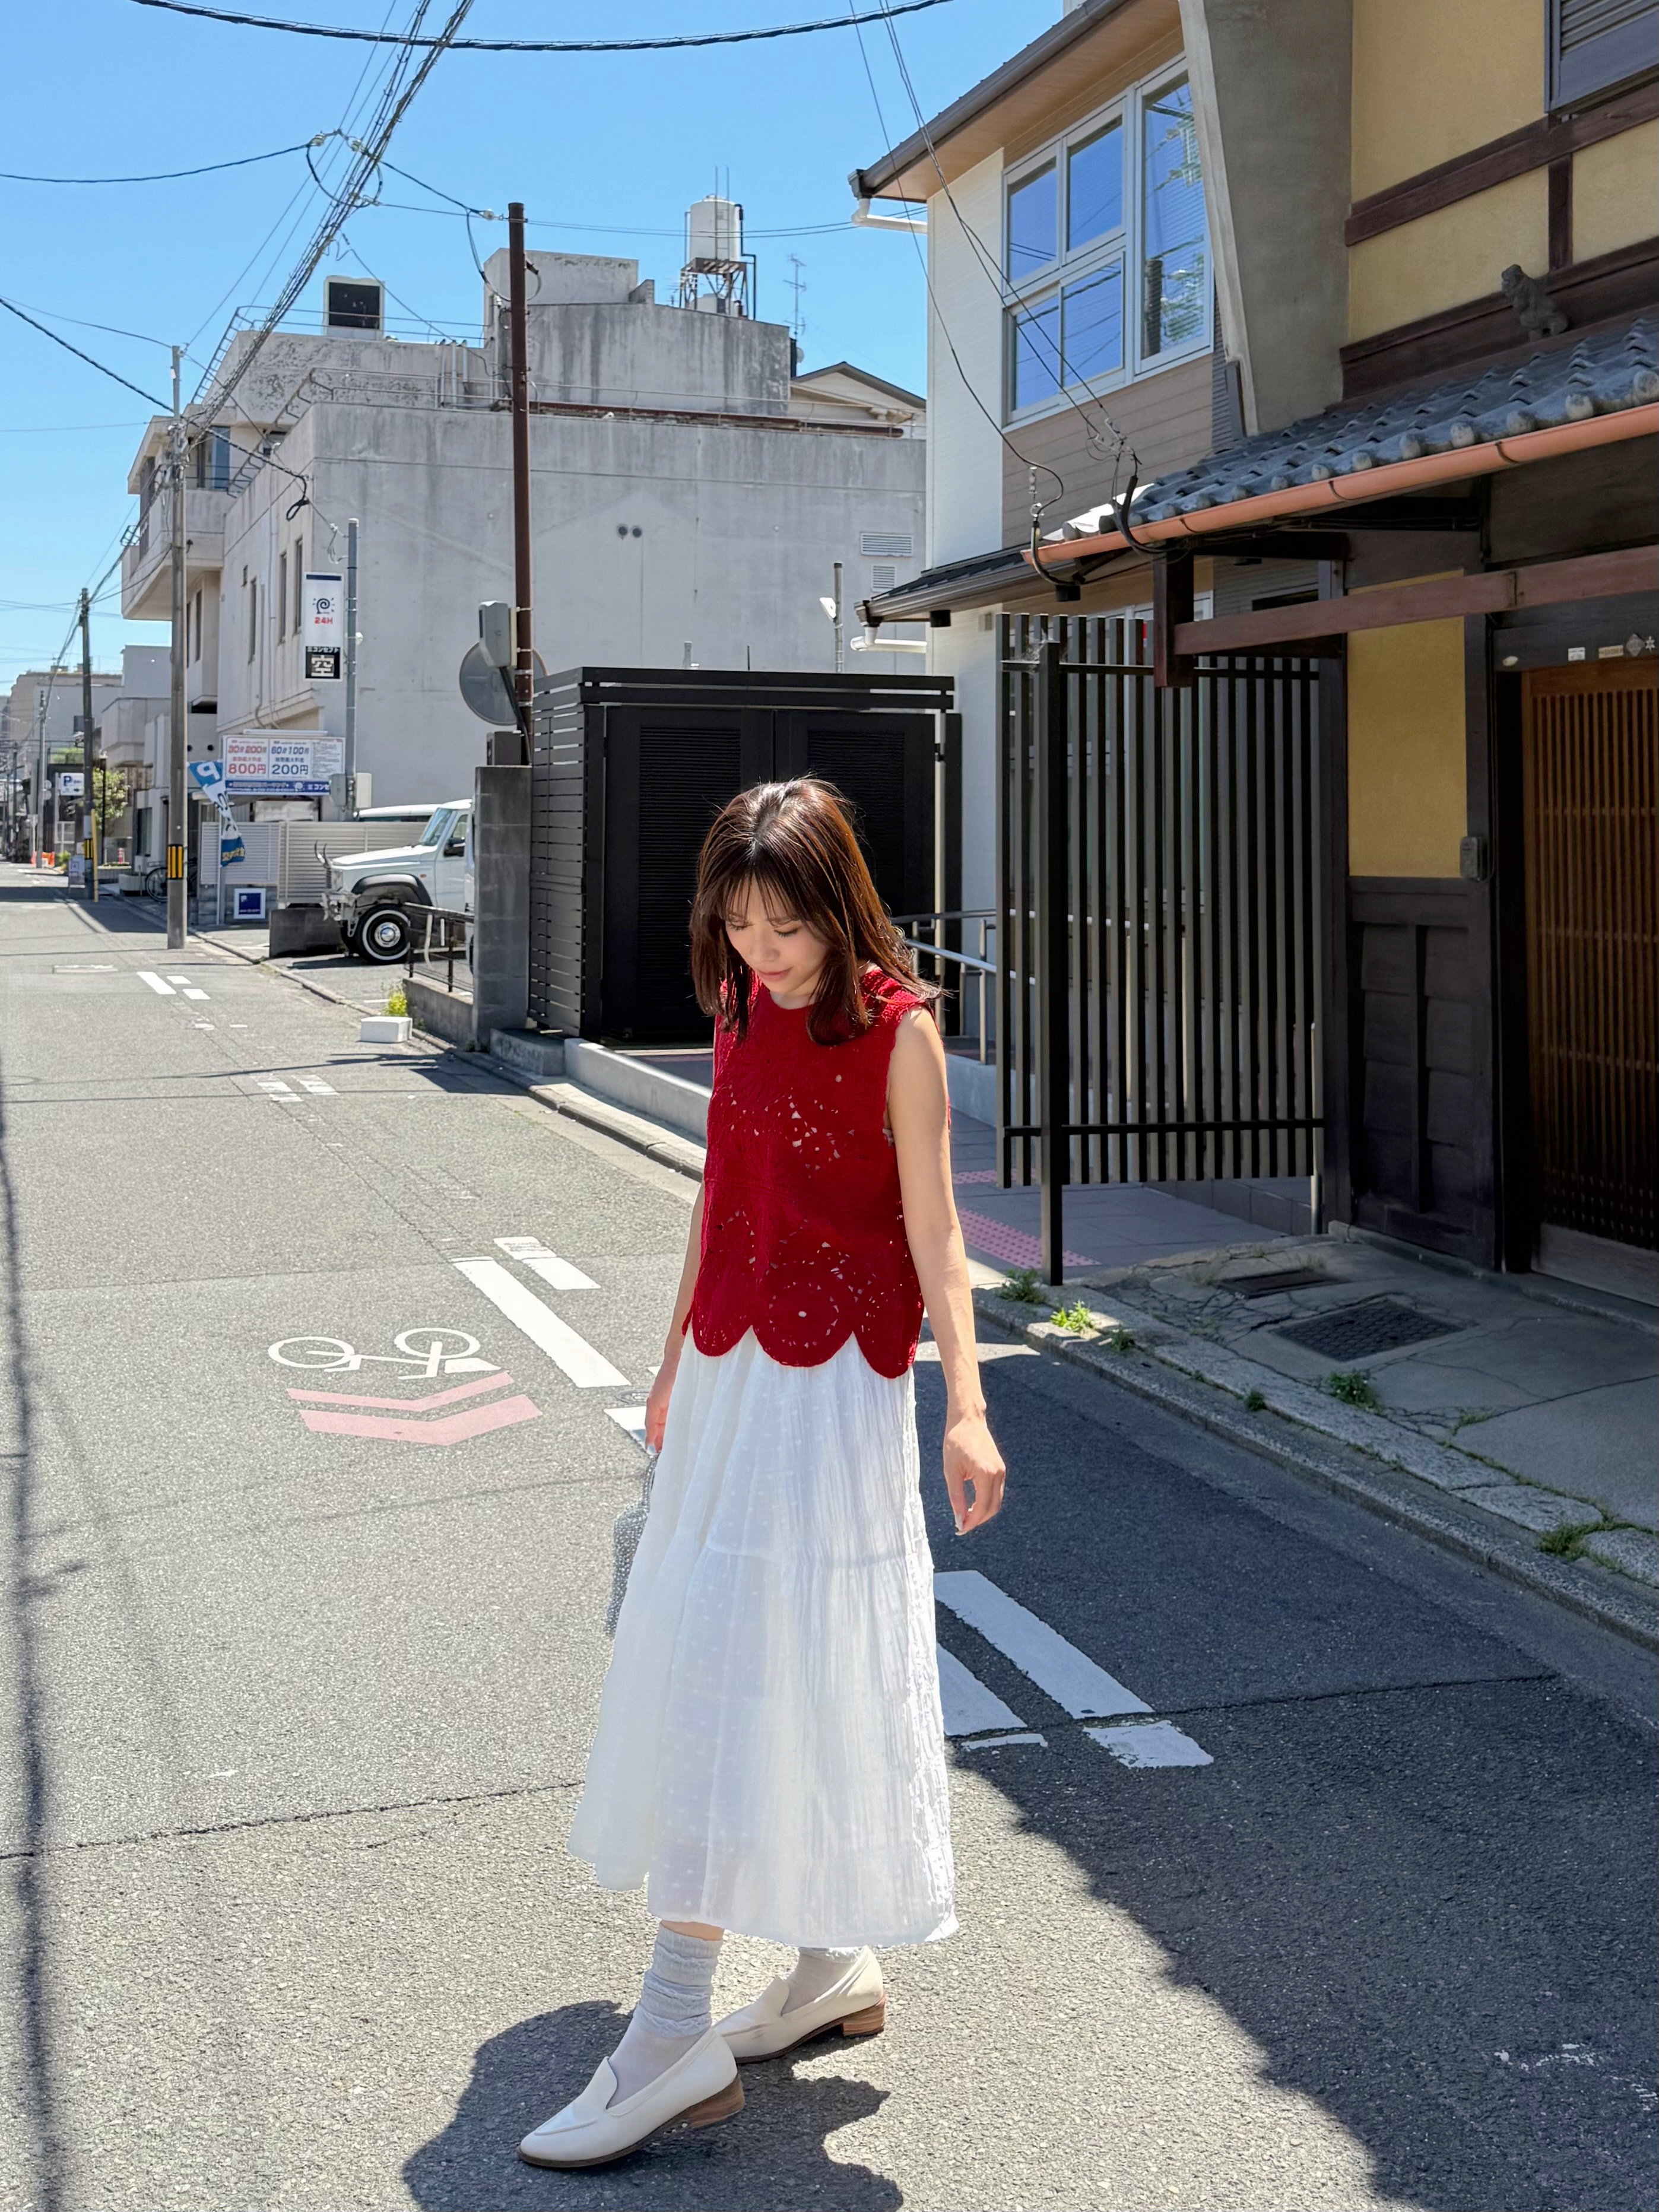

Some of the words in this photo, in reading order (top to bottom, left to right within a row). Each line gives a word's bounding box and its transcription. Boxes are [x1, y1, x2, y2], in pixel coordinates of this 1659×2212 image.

[311, 655, 334, 677] 空
[228, 763, 267, 775] 800円
[271, 764, 309, 775] 200円
[64, 775, 72, 786] P
